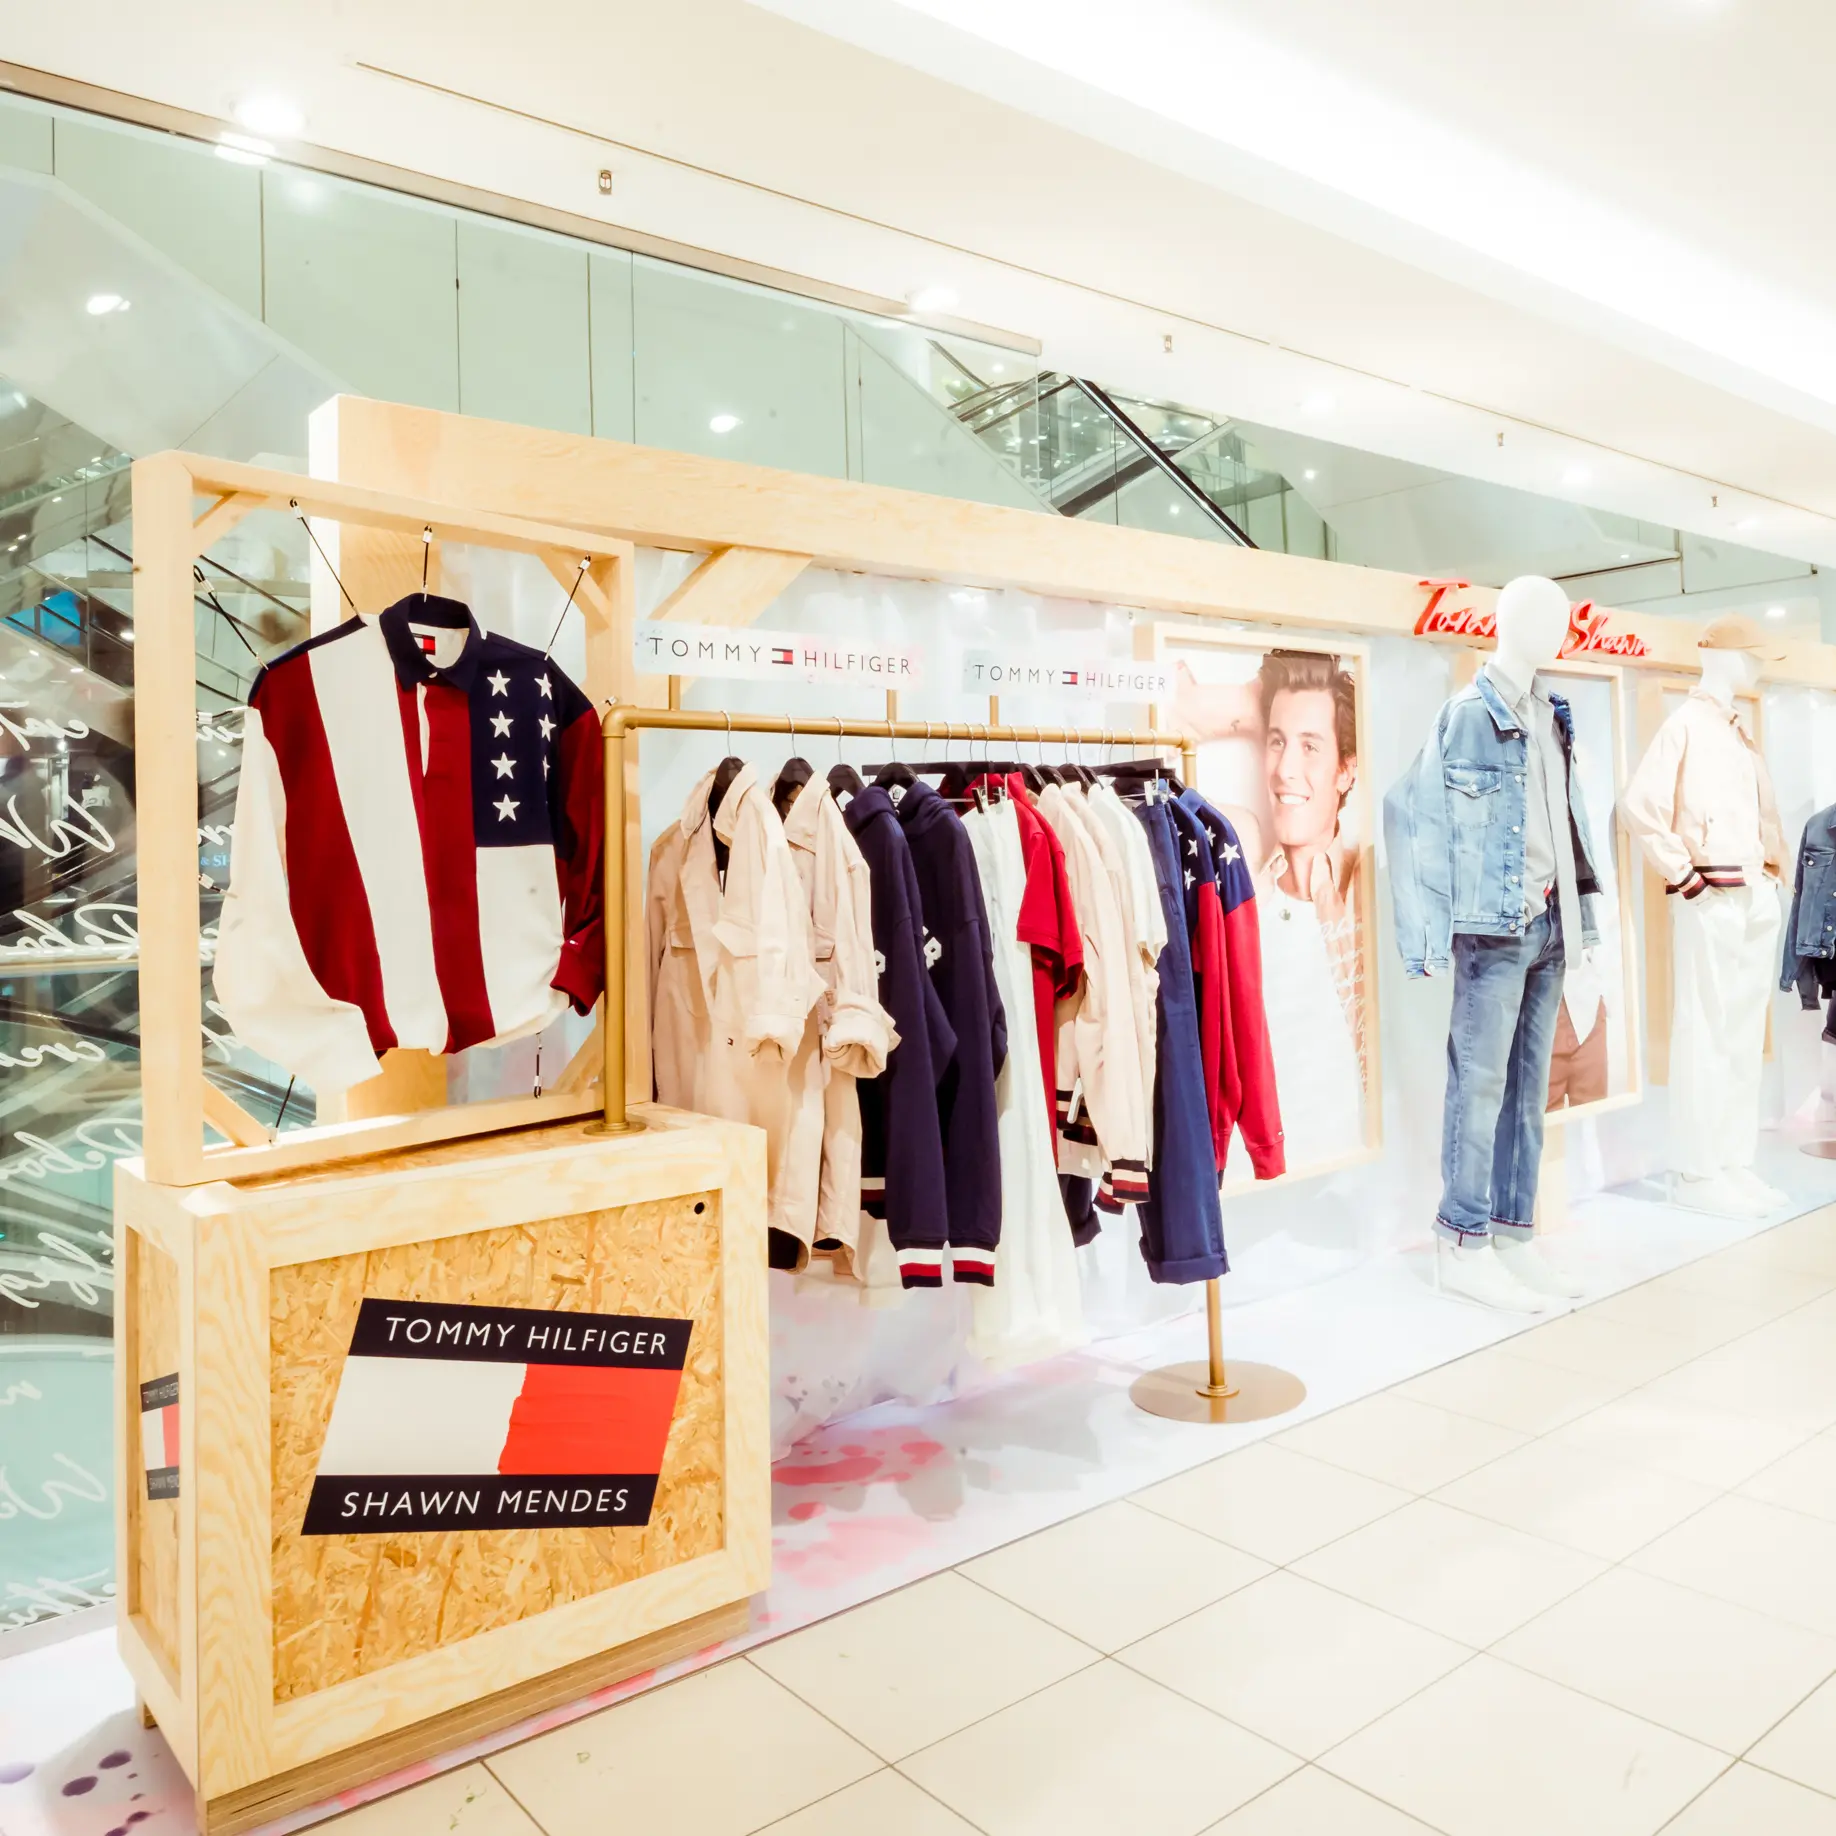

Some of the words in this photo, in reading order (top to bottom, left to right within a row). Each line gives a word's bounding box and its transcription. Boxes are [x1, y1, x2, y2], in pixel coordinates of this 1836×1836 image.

[1556, 598, 1652, 660] Shawn
[649, 636, 761, 663] TOMMY
[803, 649, 912, 675] HILFIGER
[974, 664, 1056, 684] TOMMY
[1085, 671, 1166, 692] HILFIGER
[385, 1317, 516, 1348] TOMMY
[526, 1325, 667, 1356] HILFIGER
[340, 1490, 481, 1518] SHAWN
[496, 1488, 630, 1515] MENDES
